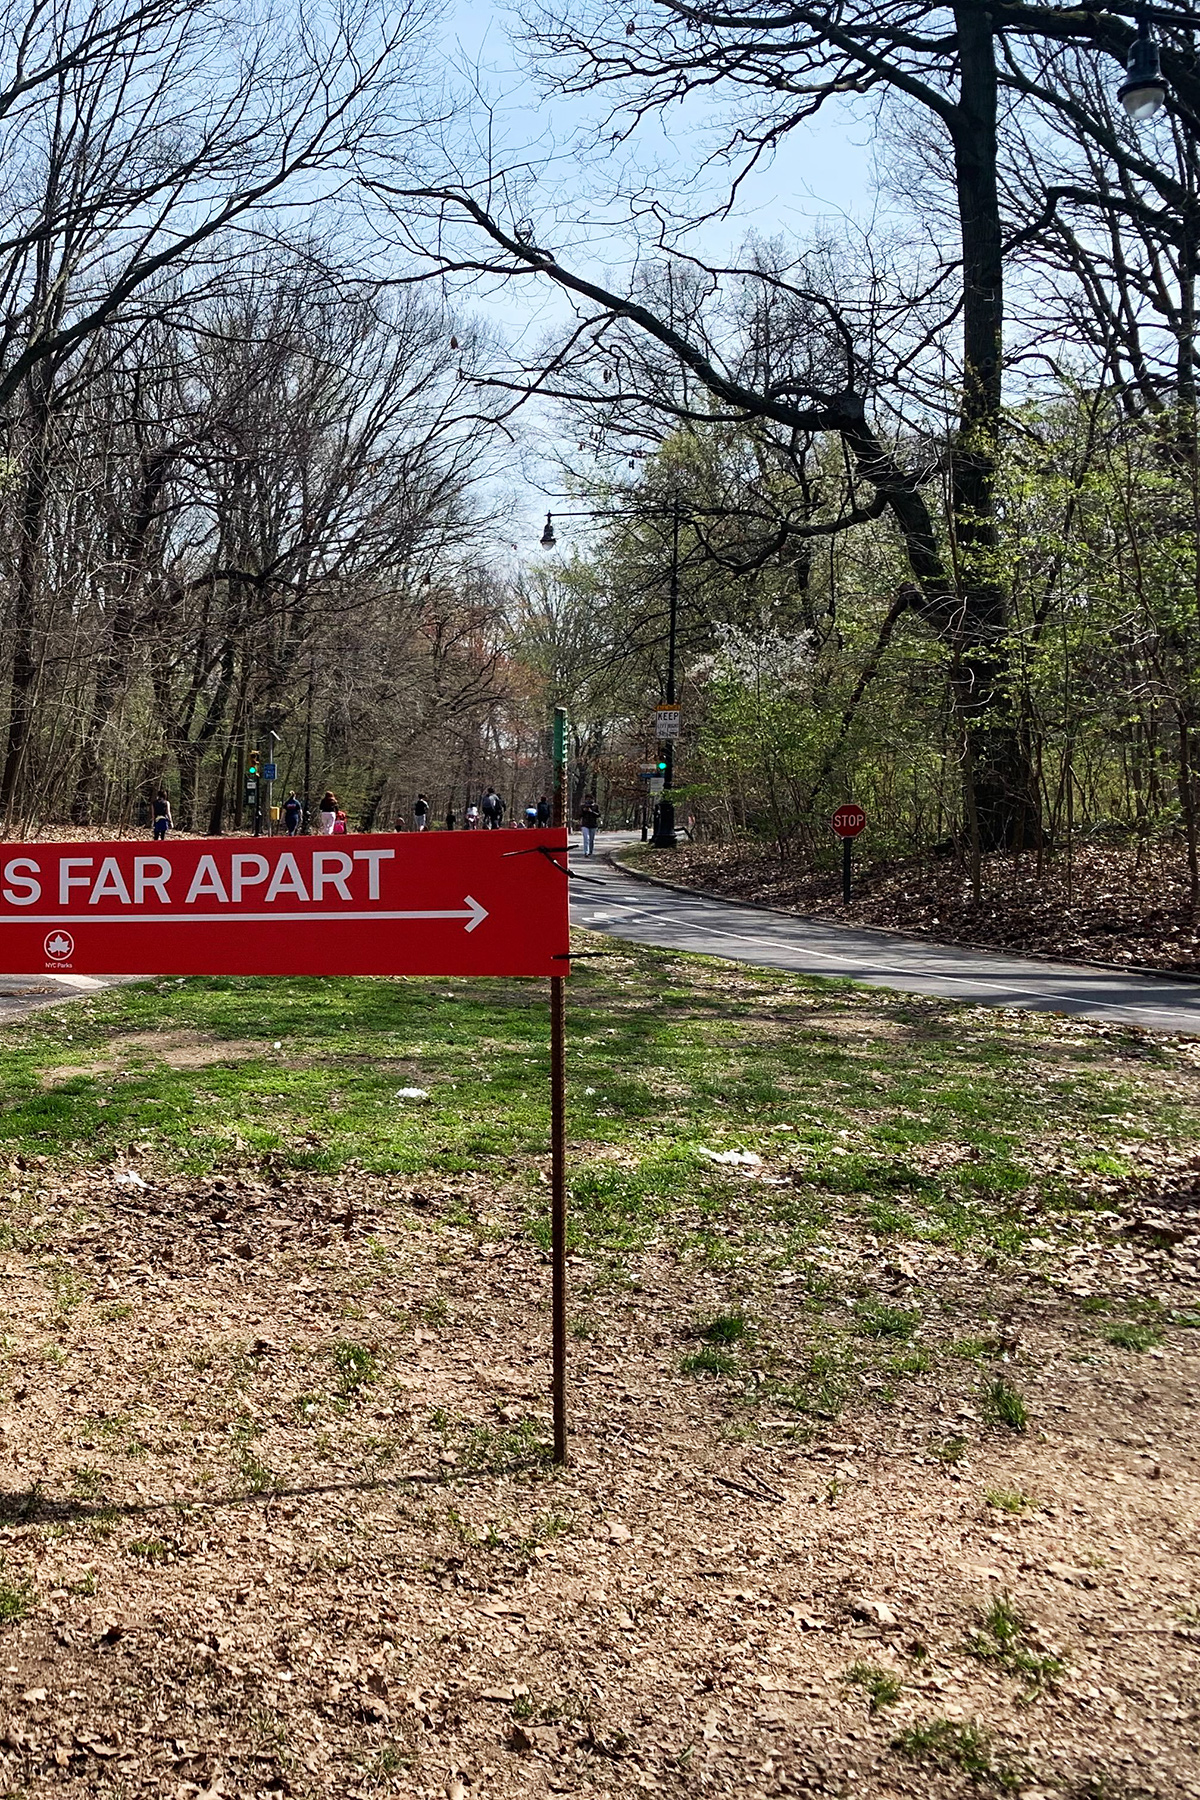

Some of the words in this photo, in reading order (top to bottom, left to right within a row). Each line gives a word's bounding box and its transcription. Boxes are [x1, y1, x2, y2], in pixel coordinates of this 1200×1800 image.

[658, 712, 679, 721] KEEP
[834, 814, 864, 827] STOP
[58, 856, 172, 904] FAR
[184, 849, 396, 904] APART
